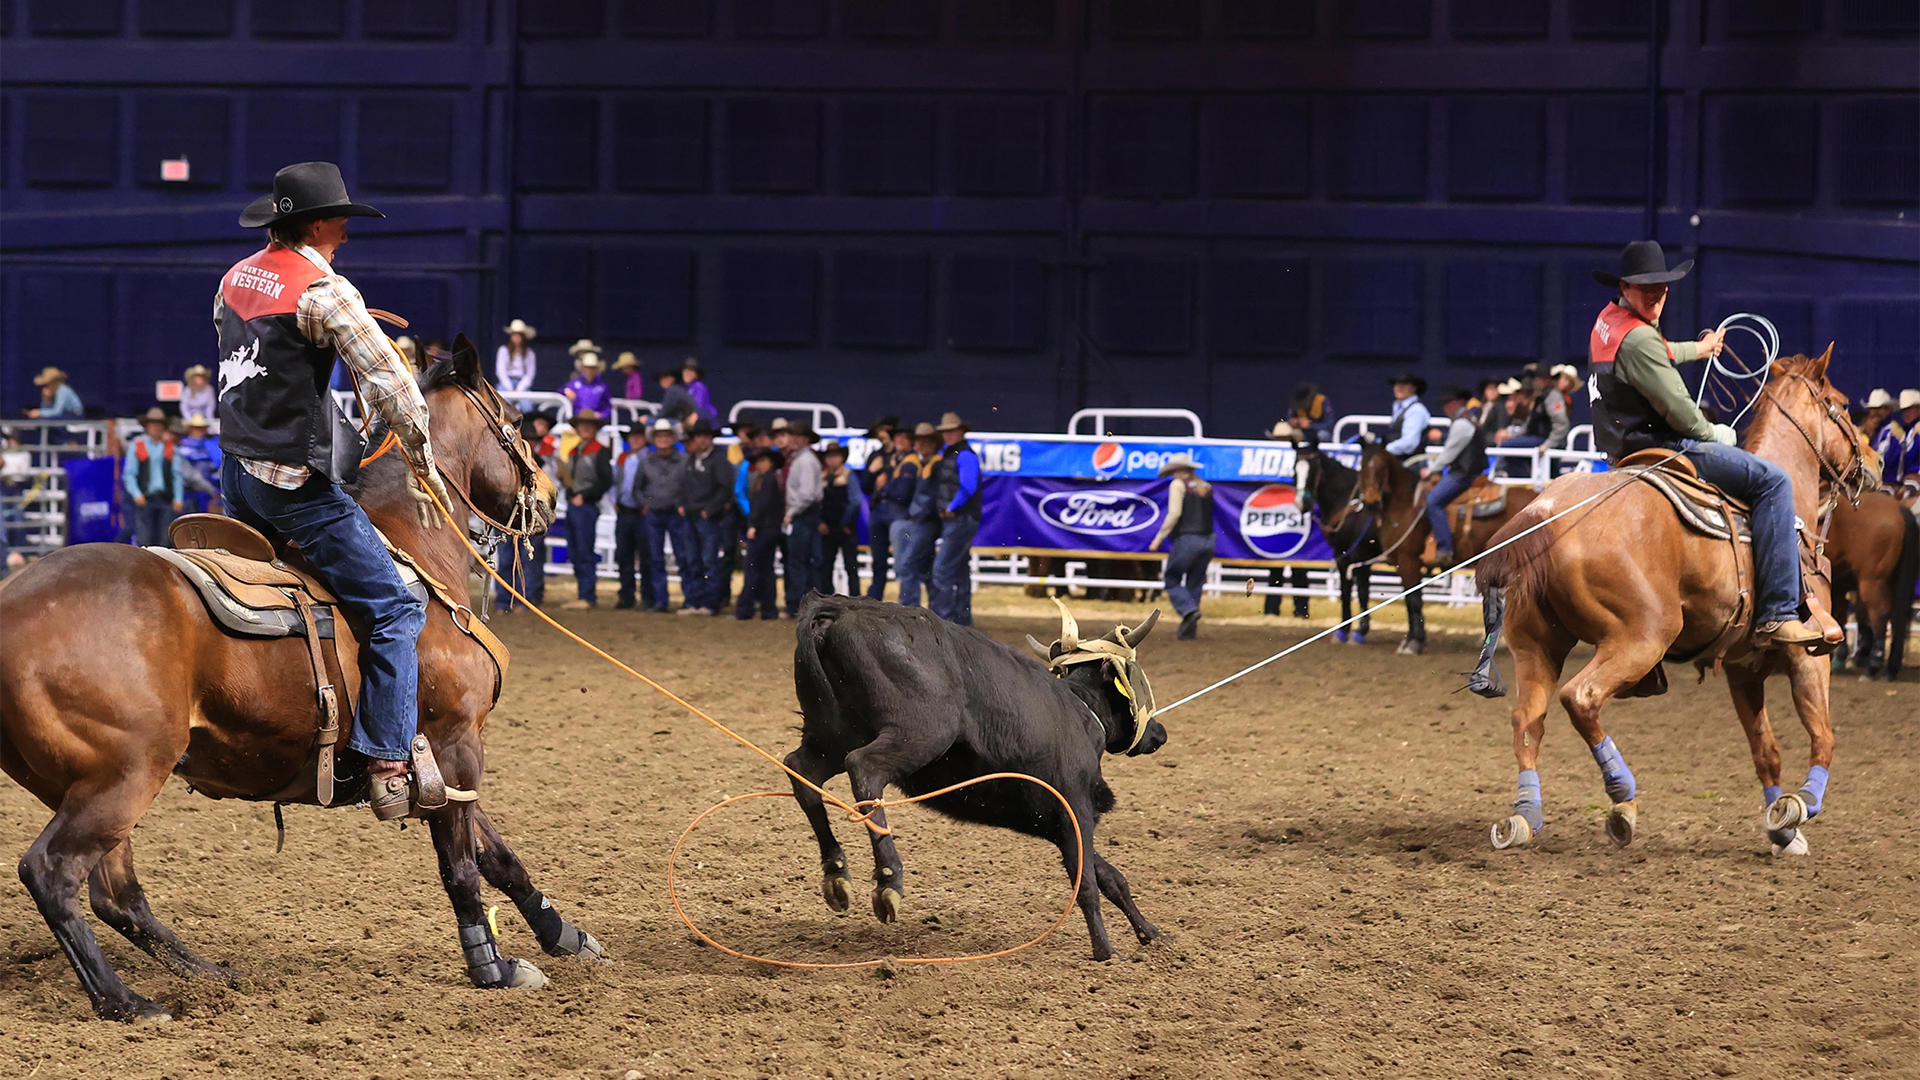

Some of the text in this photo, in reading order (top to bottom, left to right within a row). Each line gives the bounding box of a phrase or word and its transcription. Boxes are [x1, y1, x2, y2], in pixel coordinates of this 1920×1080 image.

[230, 271, 286, 300] WESTERN
[242, 264, 280, 281] MONTANA
[1126, 448, 1195, 474] pepi
[1060, 493, 1136, 528] Ford
[1246, 511, 1305, 528] PEPSI
